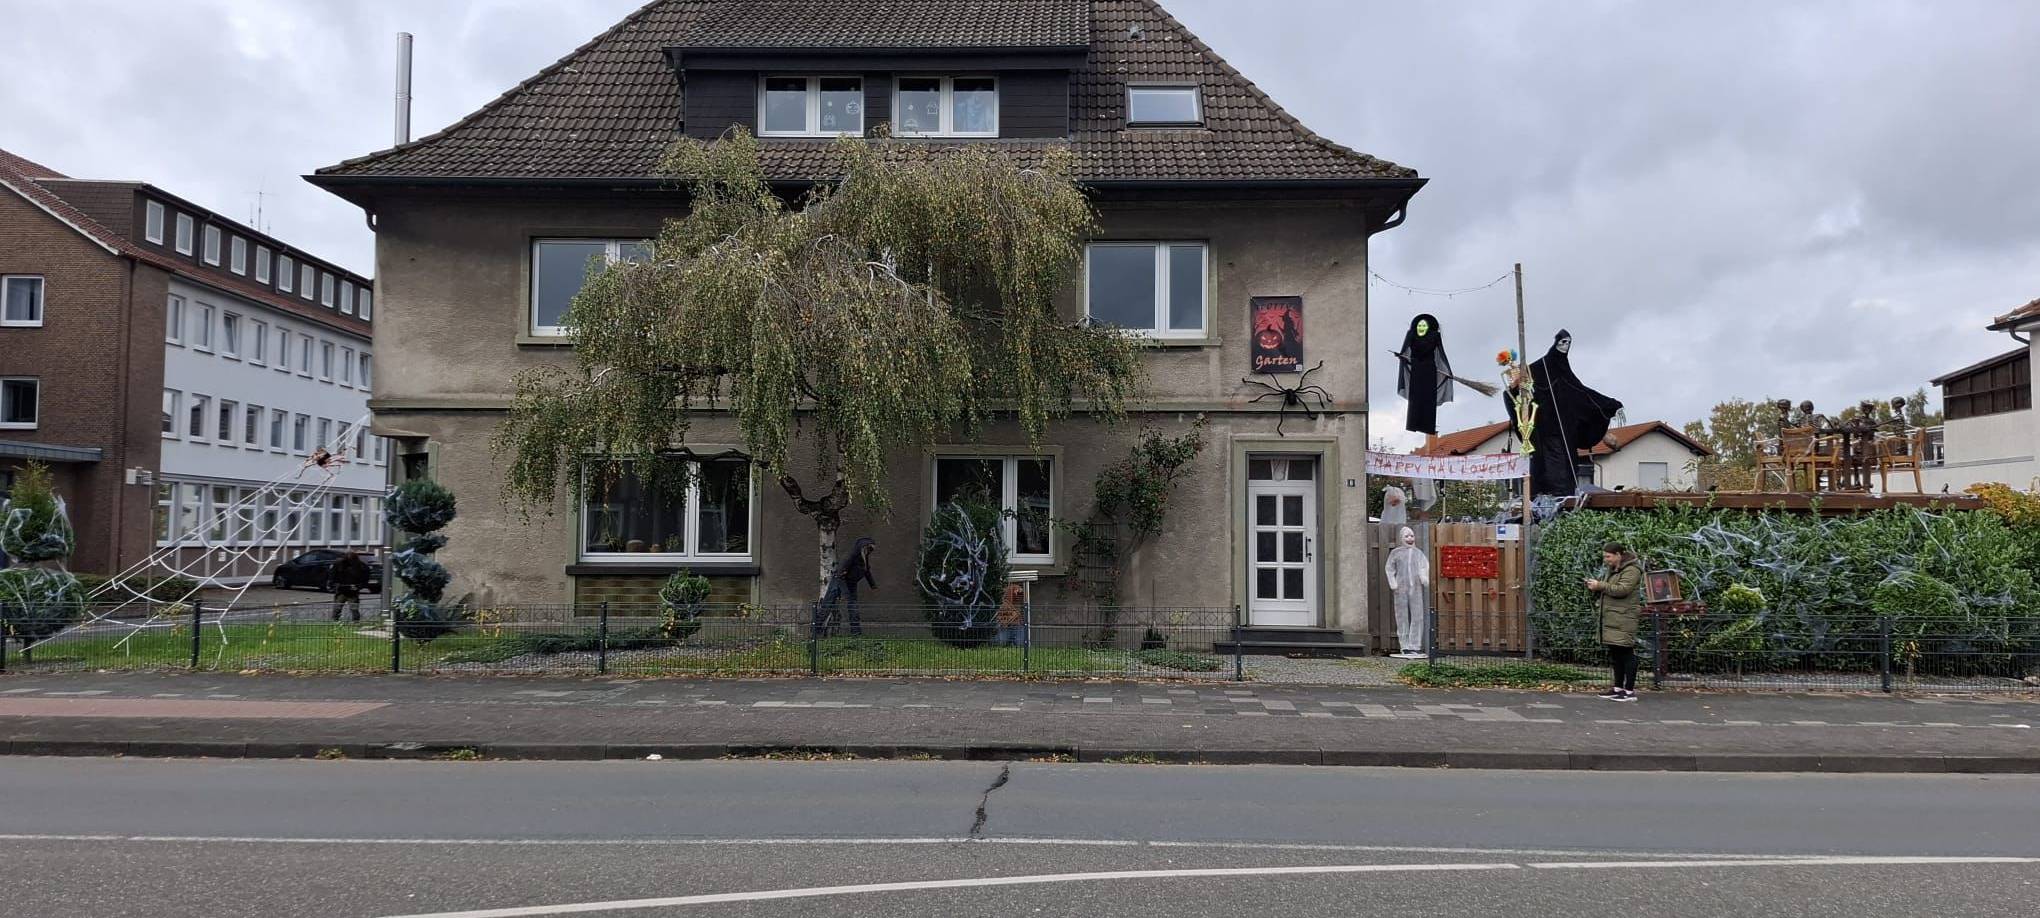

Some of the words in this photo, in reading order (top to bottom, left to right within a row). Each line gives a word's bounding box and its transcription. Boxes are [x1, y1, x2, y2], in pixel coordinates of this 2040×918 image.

[1255, 355, 1298, 370] Garten
[1374, 457, 1421, 473] HAPPY
[1428, 460, 1517, 474] HALLOWEEN
